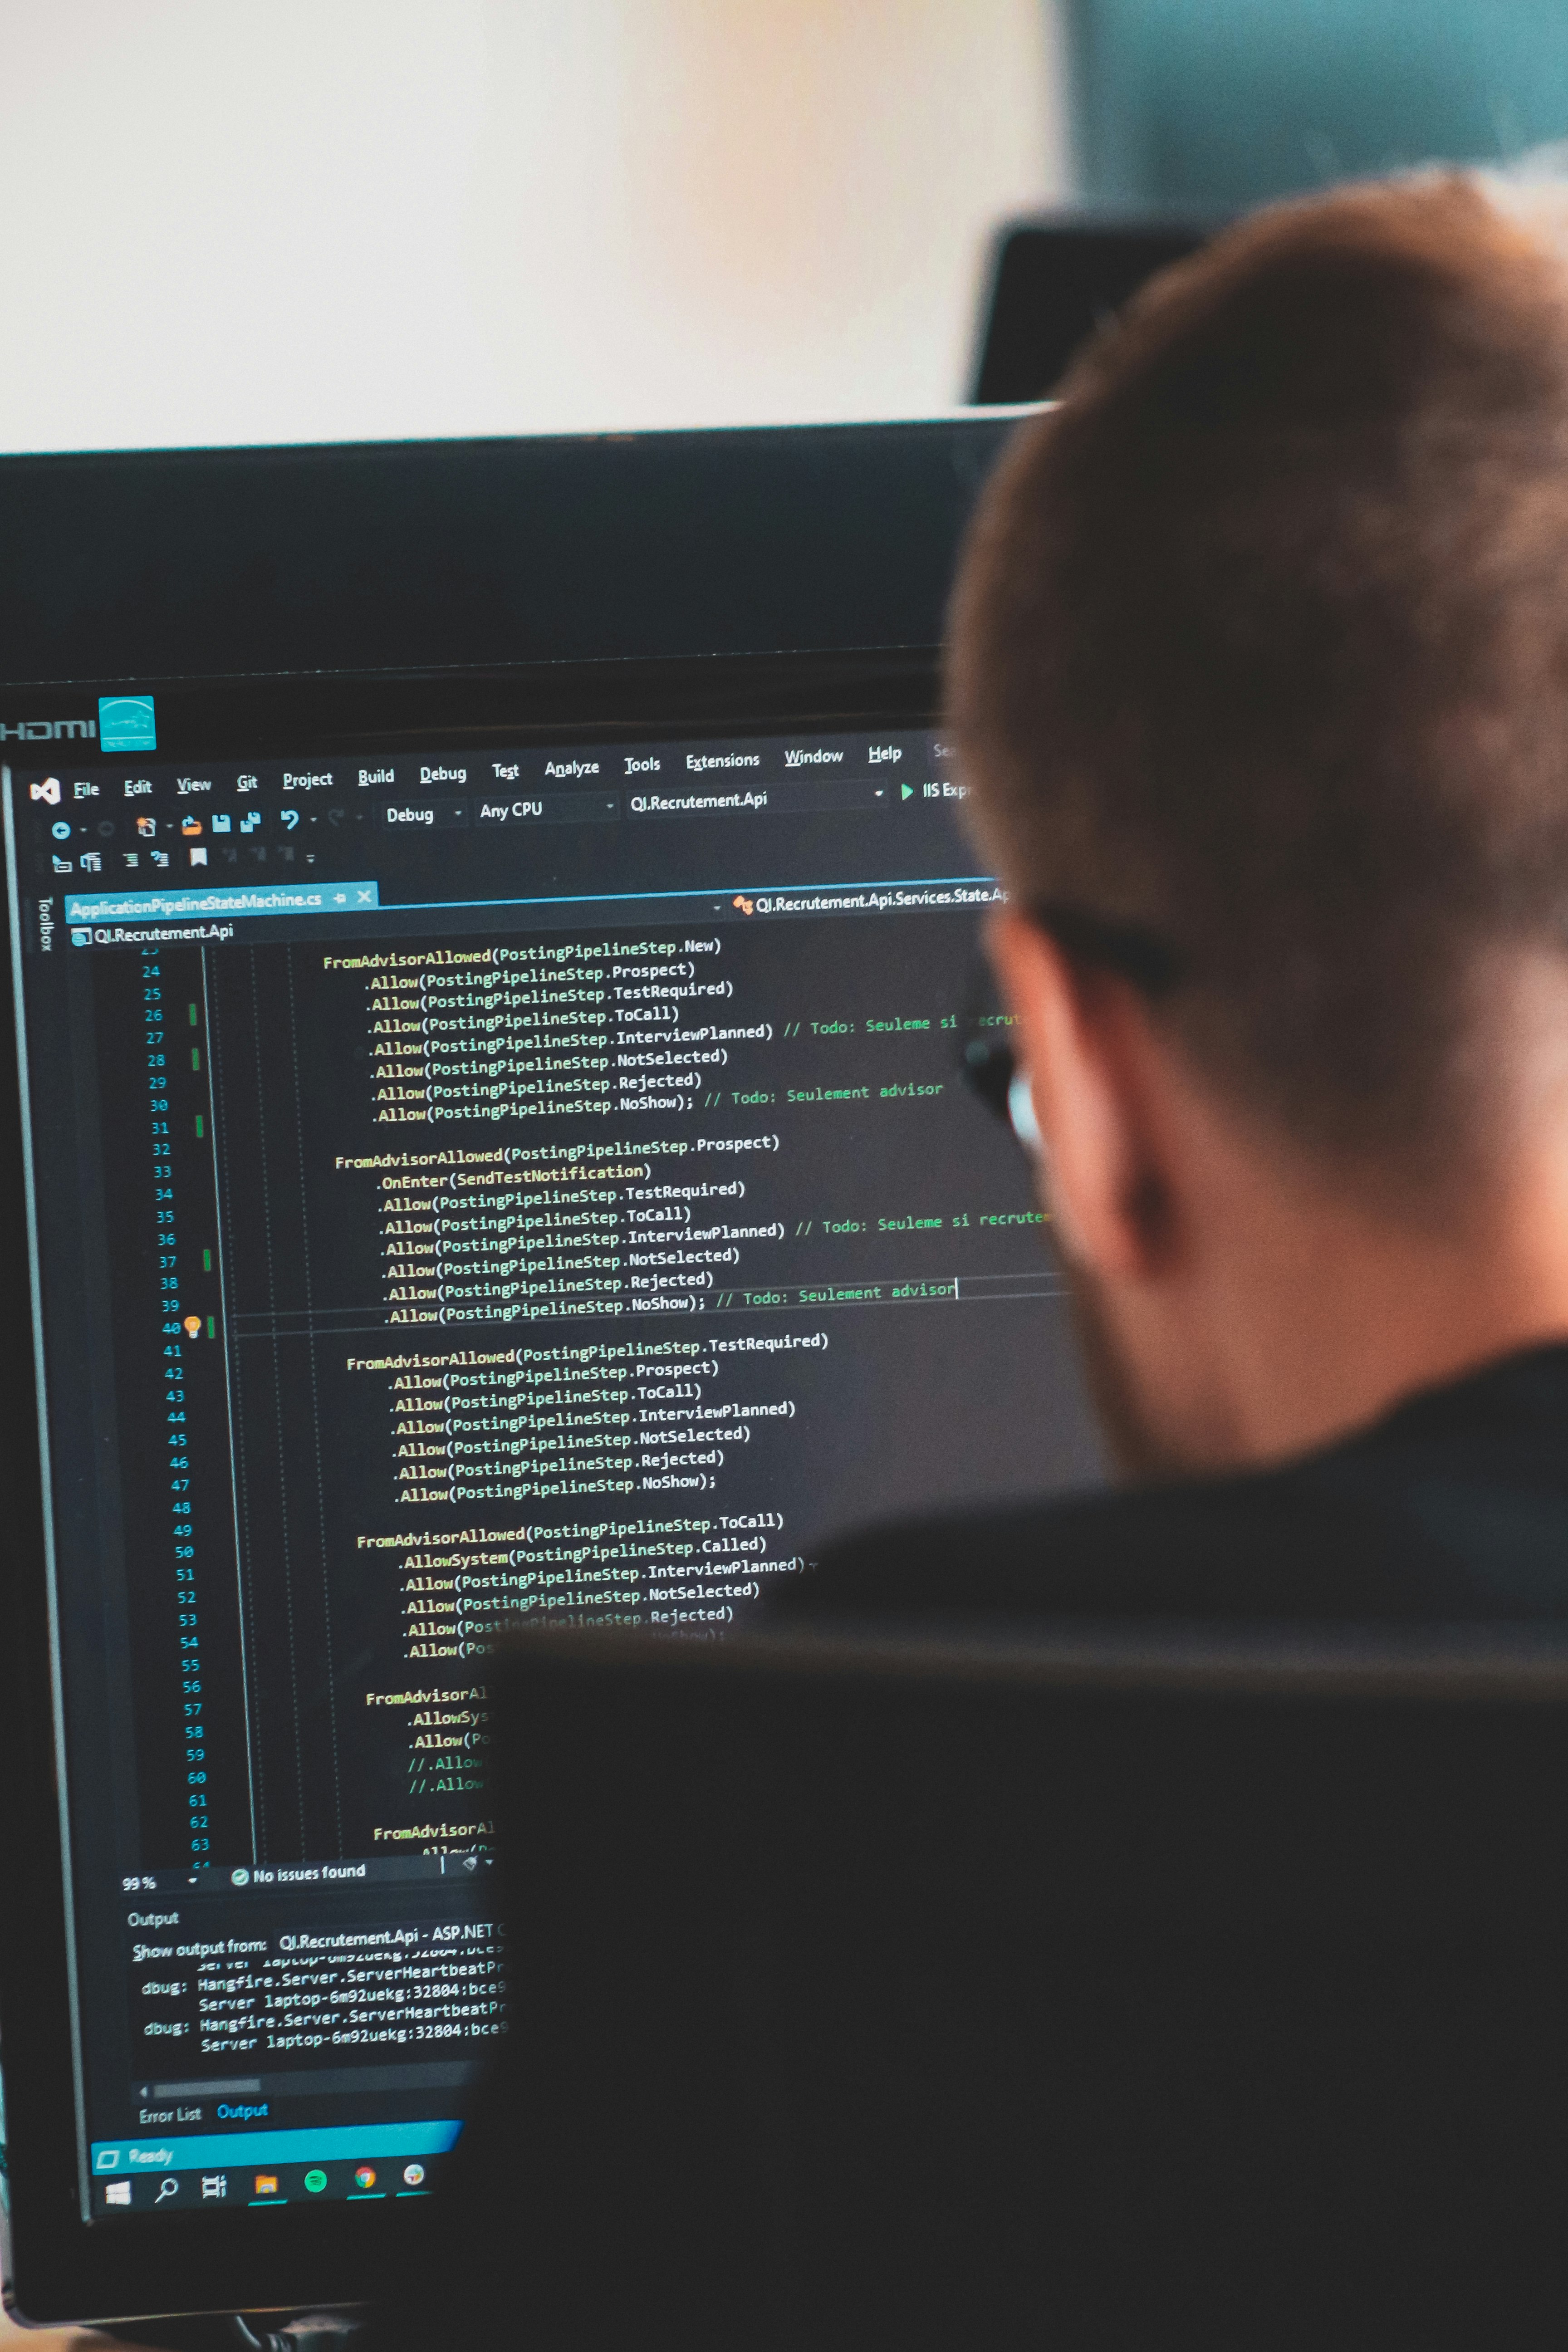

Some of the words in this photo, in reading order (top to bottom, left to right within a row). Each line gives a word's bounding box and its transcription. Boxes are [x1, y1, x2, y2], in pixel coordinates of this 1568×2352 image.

[74, 782, 100, 799] File
[124, 779, 152, 797] Edit
[177, 777, 211, 794] View
[236, 775, 258, 792] Git
[283, 772, 333, 789] Project
[358, 768, 394, 786] Build
[420, 764, 467, 784] Debug
[492, 762, 519, 779] Test
[545, 760, 599, 777] Analyze
[624, 757, 661, 774] Tools
[686, 752, 760, 771] Extensions
[784, 749, 843, 766] Window
[868, 745, 902, 763] Help
[387, 808, 433, 825] Debug
[480, 803, 508, 819] Any
[511, 802, 543, 818] CPU
[923, 782, 940, 798] IIS
[70, 892, 321, 918] ApplicationPipelineStateMachine.cs
[38, 896, 54, 952] Toolbox
[323, 938, 721, 969] FromAdvisorAllowed(PostingPipelineStep.New)
[142, 965, 160, 978] 24
[365, 961, 695, 991] .Allow(PostingPipelineStep.Prospect)
[144, 988, 162, 1000] 25
[367, 981, 733, 1012] .Allow(PostingPipelineStep.TestRequired)
[145, 1009, 163, 1022] 26
[368, 1006, 679, 1034] .Allow(PostingPipelineStep.ToCall)
[147, 1032, 164, 1044] 27
[369, 1024, 773, 1057] .Allow(PostingPipelineStep.InterviewPlanned)
[784, 1023, 800, 1037] //
[810, 1020, 854, 1034] Todo:
[866, 1017, 930, 1032] Seuleme
[941, 1014, 957, 1028] si
[148, 1054, 166, 1067] 28
[370, 1048, 728, 1080] .Allow(PostingPipelineStep.NotSelected)
[149, 1077, 167, 1089] 29
[372, 1072, 701, 1102] .Allow(PostingPipelineStep.Rejected)
[151, 1099, 169, 1112] 30
[373, 1094, 693, 1123] .Allow(PostingPipelineStep.NoShow);
[705, 1093, 720, 1107] //
[731, 1091, 775, 1104] Todo:
[787, 1087, 869, 1102] Seulement
[880, 1083, 943, 1097] advisor
[152, 1122, 169, 1134] 31
[153, 1143, 171, 1156] 32
[335, 1135, 779, 1169] FromAdvisorAllowed(PostingPipelineStep.Prospect)
[154, 1166, 172, 1178] 33
[377, 1163, 651, 1190] .OnEnter(SendTestNotification)
[155, 1188, 173, 1200] 34
[378, 1181, 745, 1213] .Allow(PostingPipelineStep.TestRequired)
[157, 1211, 174, 1223] 35
[379, 1206, 691, 1235] .Allow(PostingPipelineStep.ToCall)
[158, 1234, 176, 1246] 36
[381, 1222, 784, 1257] .Allow(PostingPipelineStep.InterviewPlanned)
[796, 1221, 812, 1235] //
[823, 1220, 866, 1233] Todo:
[878, 1216, 942, 1231] Seuleme
[953, 1213, 970, 1227] si
[159, 1256, 177, 1268] 37
[382, 1248, 740, 1279] .Allow(PostingPipelineStep.NotSelected)
[160, 1277, 179, 1289] 38
[383, 1271, 713, 1302] .Allow(PostingPipelineStep.Rejected)
[162, 1300, 180, 1312] 39
[384, 1295, 705, 1325] .Allow(PostingPipelineStep.NoShow);
[717, 1293, 732, 1307] //
[743, 1291, 787, 1304] Todo:
[799, 1287, 881, 1302] Seulement
[892, 1280, 956, 1297] advisor
[162, 1323, 181, 1334] 40
[163, 1345, 182, 1357] 41
[347, 1333, 828, 1370] FromAdvisorAllowed(PostingPipelineStep.TestRequired)
[165, 1367, 183, 1379] 42
[388, 1361, 718, 1391] .Allow(PostingPipelineStep.Prospect)
[166, 1390, 185, 1402] 43
[390, 1383, 701, 1413] .Allow(PostingPipelineStep.ToCall)
[167, 1411, 186, 1423] 44
[391, 1402, 795, 1436] .Allow(PostingPipelineStep.InterviewPlanned)
[168, 1434, 187, 1446] 45
[392, 1427, 750, 1458] .Allow(PostingPipelineStep.NotSelected)
[170, 1456, 189, 1469] 46
[393, 1451, 724, 1481] .Allow(PostingPipelineStep.Rejected)
[171, 1479, 190, 1491] 47
[395, 1474, 715, 1503] .Allow(PostingPipelineStep.NoShow);
[172, 1502, 191, 1514] 48
[173, 1524, 193, 1536] 49
[358, 1514, 784, 1548] FromAdvisorAllowed(PostingPipelineStep.ToCall)
[175, 1546, 195, 1558] 50
[399, 1537, 766, 1569] .AllowSystem(PostingPipelineStep.Called)
[176, 1568, 194, 1581] 51
[400, 1557, 804, 1592] .Allow(PostingPipelineStep.InterviewPlanned)
[178, 1591, 196, 1603] 52
[402, 1583, 759, 1615] .Allow(PostingPipelineStep.NotSelected)
[179, 1614, 197, 1626] 53
[180, 1637, 199, 1649] 54
[181, 1659, 200, 1671] 55
[183, 1681, 201, 1693] 56
[184, 1703, 202, 1716] 57
[185, 1726, 204, 1739] 58
[186, 1749, 205, 1761] 59
[187, 1771, 207, 1784] 60
[189, 1794, 207, 1807] 61
[190, 1815, 208, 1828] 62
[191, 1838, 210, 1851] 63
[254, 1870, 274, 1882] No
[278, 1869, 320, 1882] issues
[321, 1864, 366, 1878] found
[122, 1876, 140, 1891] 99
[142, 1876, 157, 1890] %
[128, 1911, 180, 1929] Output
[132, 1943, 173, 1962] Show
[176, 1940, 225, 1959] output
[227, 1938, 268, 1953] from:
[431, 1923, 493, 1942] ASP.NET
[142, 1980, 187, 1995] dbug:
[199, 1996, 255, 2012] Server
[144, 2020, 190, 2036] dbug:
[201, 2037, 257, 2052] Server
[139, 2109, 174, 2124] Error
[176, 2107, 202, 2121] List
[217, 2103, 269, 2120] Output
[129, 2148, 174, 2166] Ready
